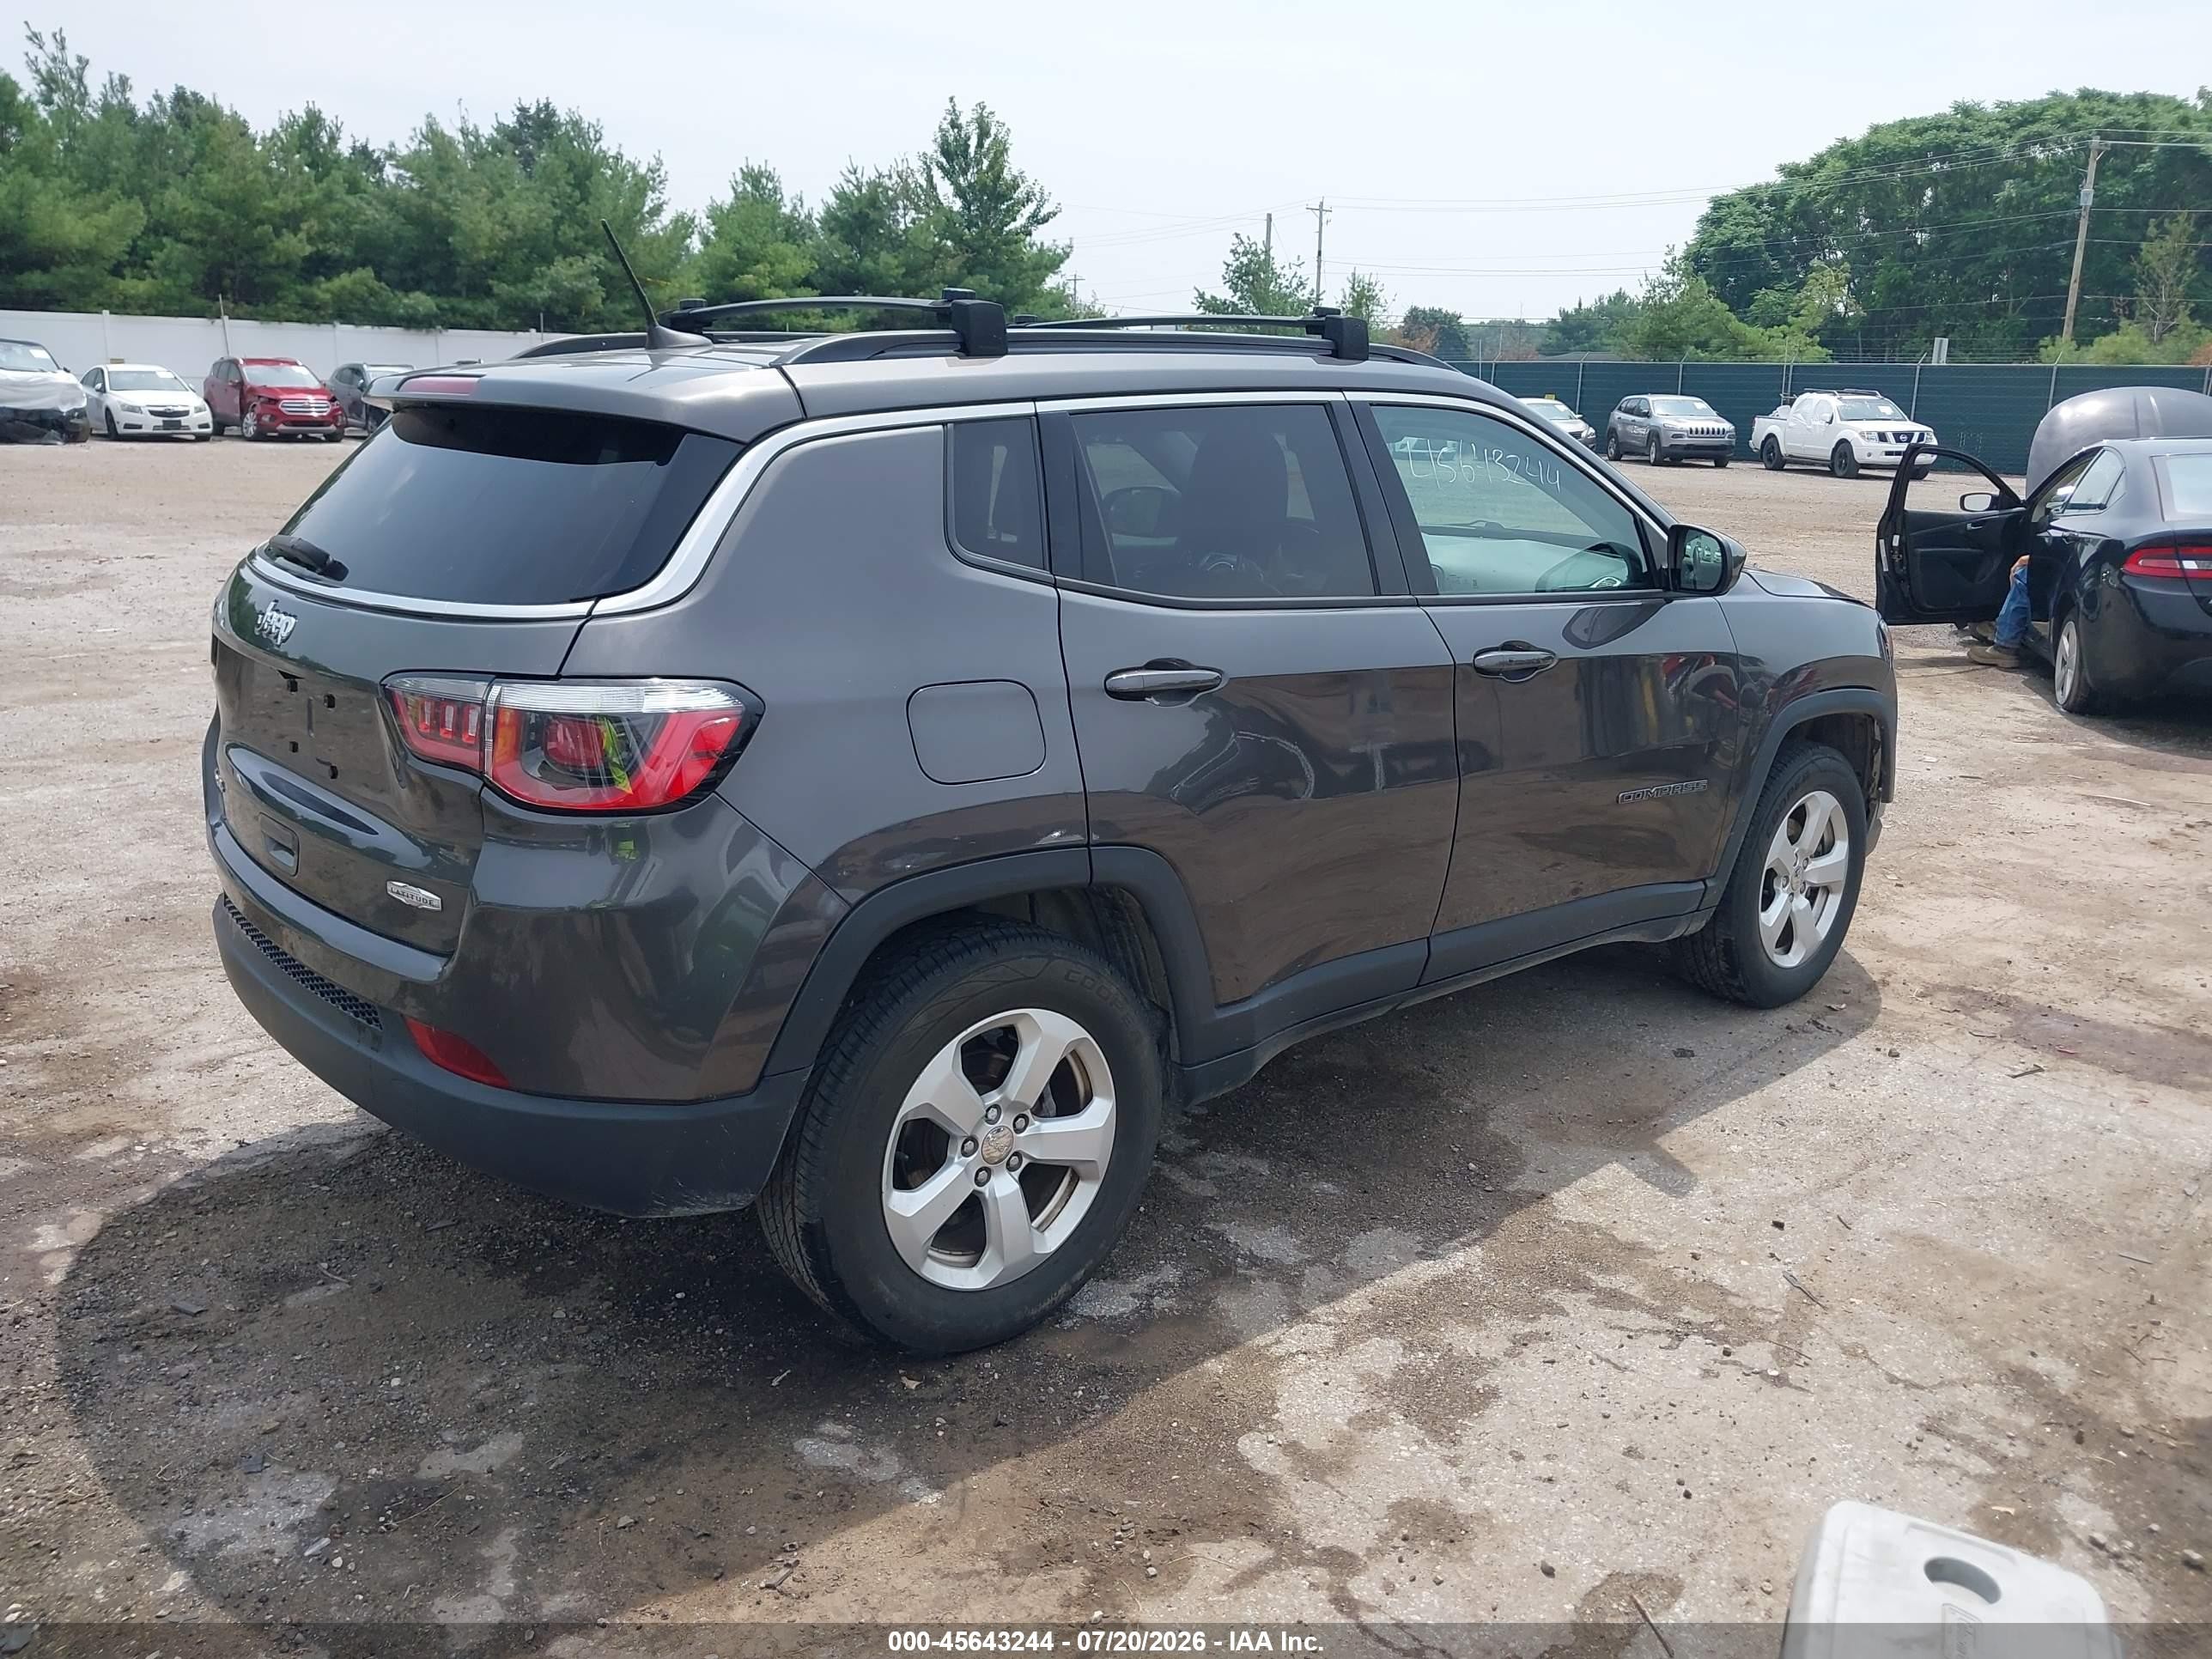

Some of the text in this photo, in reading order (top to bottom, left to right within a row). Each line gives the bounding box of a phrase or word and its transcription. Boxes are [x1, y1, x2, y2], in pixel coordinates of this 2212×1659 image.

[254, 600, 297, 646] Jeep
[1616, 779, 1709, 805] COMPASS
[391, 885, 435, 908] LATITUDE
